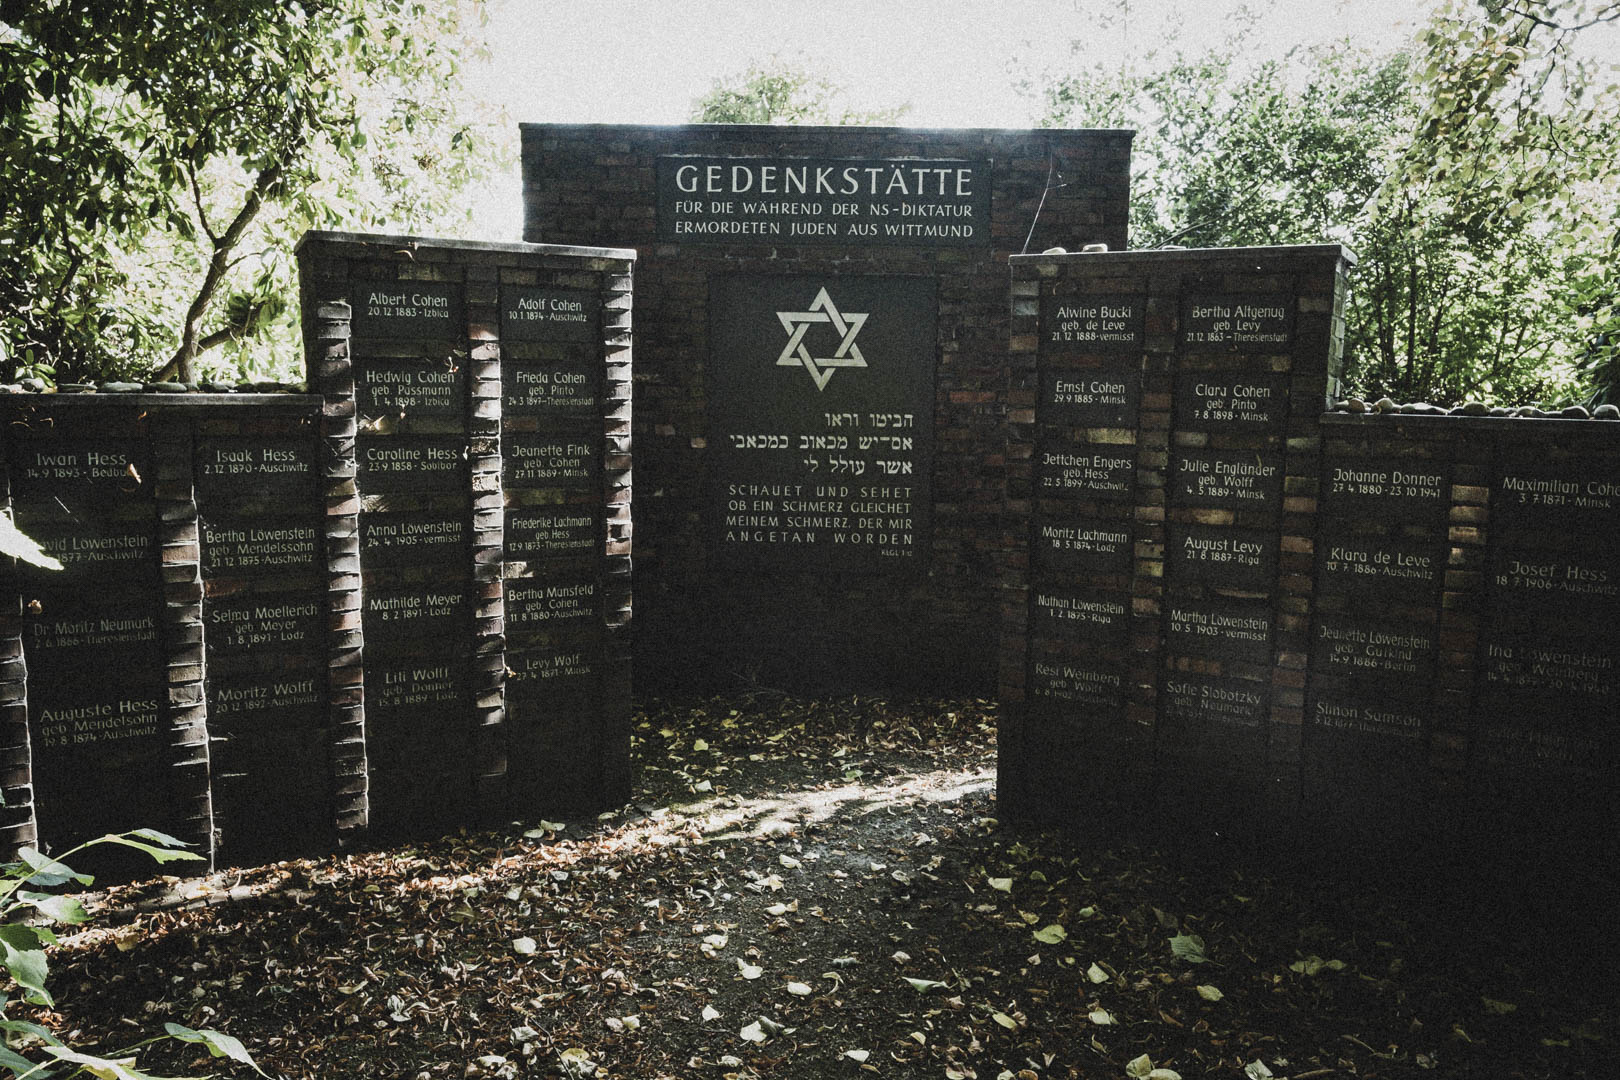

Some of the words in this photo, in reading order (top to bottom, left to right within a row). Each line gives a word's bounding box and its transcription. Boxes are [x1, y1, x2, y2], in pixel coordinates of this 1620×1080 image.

[675, 164, 973, 196] GEDENKSTÄTTE
[675, 201, 703, 215] FÜR
[711, 202, 734, 215] DIE
[742, 201, 823, 216] WÄHREND
[832, 203, 859, 216] DER
[870, 203, 973, 217] NS-DIKTATUR
[675, 221, 780, 235] ERMORDETEN
[790, 222, 838, 237] JUDEN
[848, 223, 878, 236] AUS
[885, 223, 973, 238] WITTMUND
[368, 292, 407, 306] Albert
[411, 293, 448, 307] Cohen
[518, 297, 547, 310] Adolf
[550, 299, 582, 312] Cohen
[1056, 306, 1097, 319] Alwine
[1100, 305, 1132, 319] Bucki
[1192, 305, 1231, 319] Bertha
[1234, 305, 1285, 321] Altgenug
[1086, 320, 1098, 331] de
[1102, 320, 1126, 331] Leve
[1236, 319, 1261, 332] Levy
[366, 369, 412, 385] Hedwig
[417, 370, 455, 383] Cohen
[516, 371, 548, 384] Frieda
[553, 371, 586, 384] Cohen
[551, 385, 575, 395] Pinto
[1056, 380, 1085, 393] Ernst
[1090, 381, 1126, 394] Cohen
[1195, 383, 1227, 397] Clara
[1233, 384, 1271, 398] Cohen
[1231, 398, 1257, 410] Pinto
[824, 413, 859, 428] וראו
[869, 413, 913, 428] הביטו
[729, 434, 789, 449] כמכאבי
[799, 435, 848, 450] מכאוב
[216, 449, 254, 463] Isaak
[263, 448, 296, 462] Hess
[367, 447, 421, 461] Caroline
[427, 447, 458, 460] Hess
[512, 444, 563, 457] Jeanette
[567, 443, 590, 456] Fink
[36, 453, 77, 466] Iwan
[87, 452, 127, 466] Hess
[549, 457, 580, 468] Cohen
[803, 453, 819, 473] לי
[829, 454, 865, 476] עולל
[1042, 452, 1089, 466] Jettchen
[1093, 455, 1132, 471] Engers
[876, 459, 913, 475] אשר
[1084, 468, 1109, 480] Hess
[1180, 459, 1210, 473] Julie
[1215, 461, 1276, 477] Engländer
[1224, 475, 1255, 488] Wolff
[1333, 468, 1387, 484] Johanne
[1392, 471, 1442, 487] Donner
[1503, 476, 1579, 493] Maximilian
[728, 485, 802, 497] SCHAUET
[816, 486, 849, 497] UND
[860, 487, 912, 498] SEHET
[728, 500, 747, 511] OB
[753, 501, 774, 511] EIN
[782, 501, 844, 512] SCHMERZ
[850, 502, 912, 514] GLEICHET
[726, 516, 779, 527] MEINEM
[859, 518, 882, 529] DER
[888, 518, 913, 529] MIR
[206, 530, 246, 544] Bertha
[366, 524, 397, 537] Anna
[551, 529, 570, 539] Hess
[1042, 525, 1075, 540] Moritz
[1078, 528, 1128, 543] Lachmann
[726, 532, 815, 543] ANGETAN
[834, 533, 912, 545] WORDEN
[1184, 536, 1228, 552] August
[1232, 540, 1263, 555] Levy
[237, 541, 315, 555] Mendelssohn
[1331, 547, 1367, 562] Klara
[1374, 551, 1391, 564] de
[1397, 553, 1431, 568] Leve
[1509, 560, 1557, 577] Josef
[1566, 565, 1607, 582] Hess
[508, 588, 544, 602] Bertha
[546, 583, 594, 599] Mansfeld
[370, 595, 421, 611] Mathilde
[426, 593, 462, 607] Meyer
[548, 599, 578, 610] Cohen
[1038, 594, 1070, 609] Nathan
[212, 609, 250, 623] Selma
[255, 603, 318, 619] Moellerich
[1171, 609, 1207, 624] Martha
[55, 620, 95, 635] Moritz
[100, 616, 154, 632] Neumark
[260, 620, 297, 632] Meyer
[526, 658, 551, 671] Levy
[554, 653, 582, 667] Wolf
[1063, 666, 1120, 687] Weinberg
[218, 686, 268, 702] Moritz
[1166, 681, 1198, 696] Sofie
[40, 703, 112, 722] Auguste
[119, 699, 158, 713] Hess
